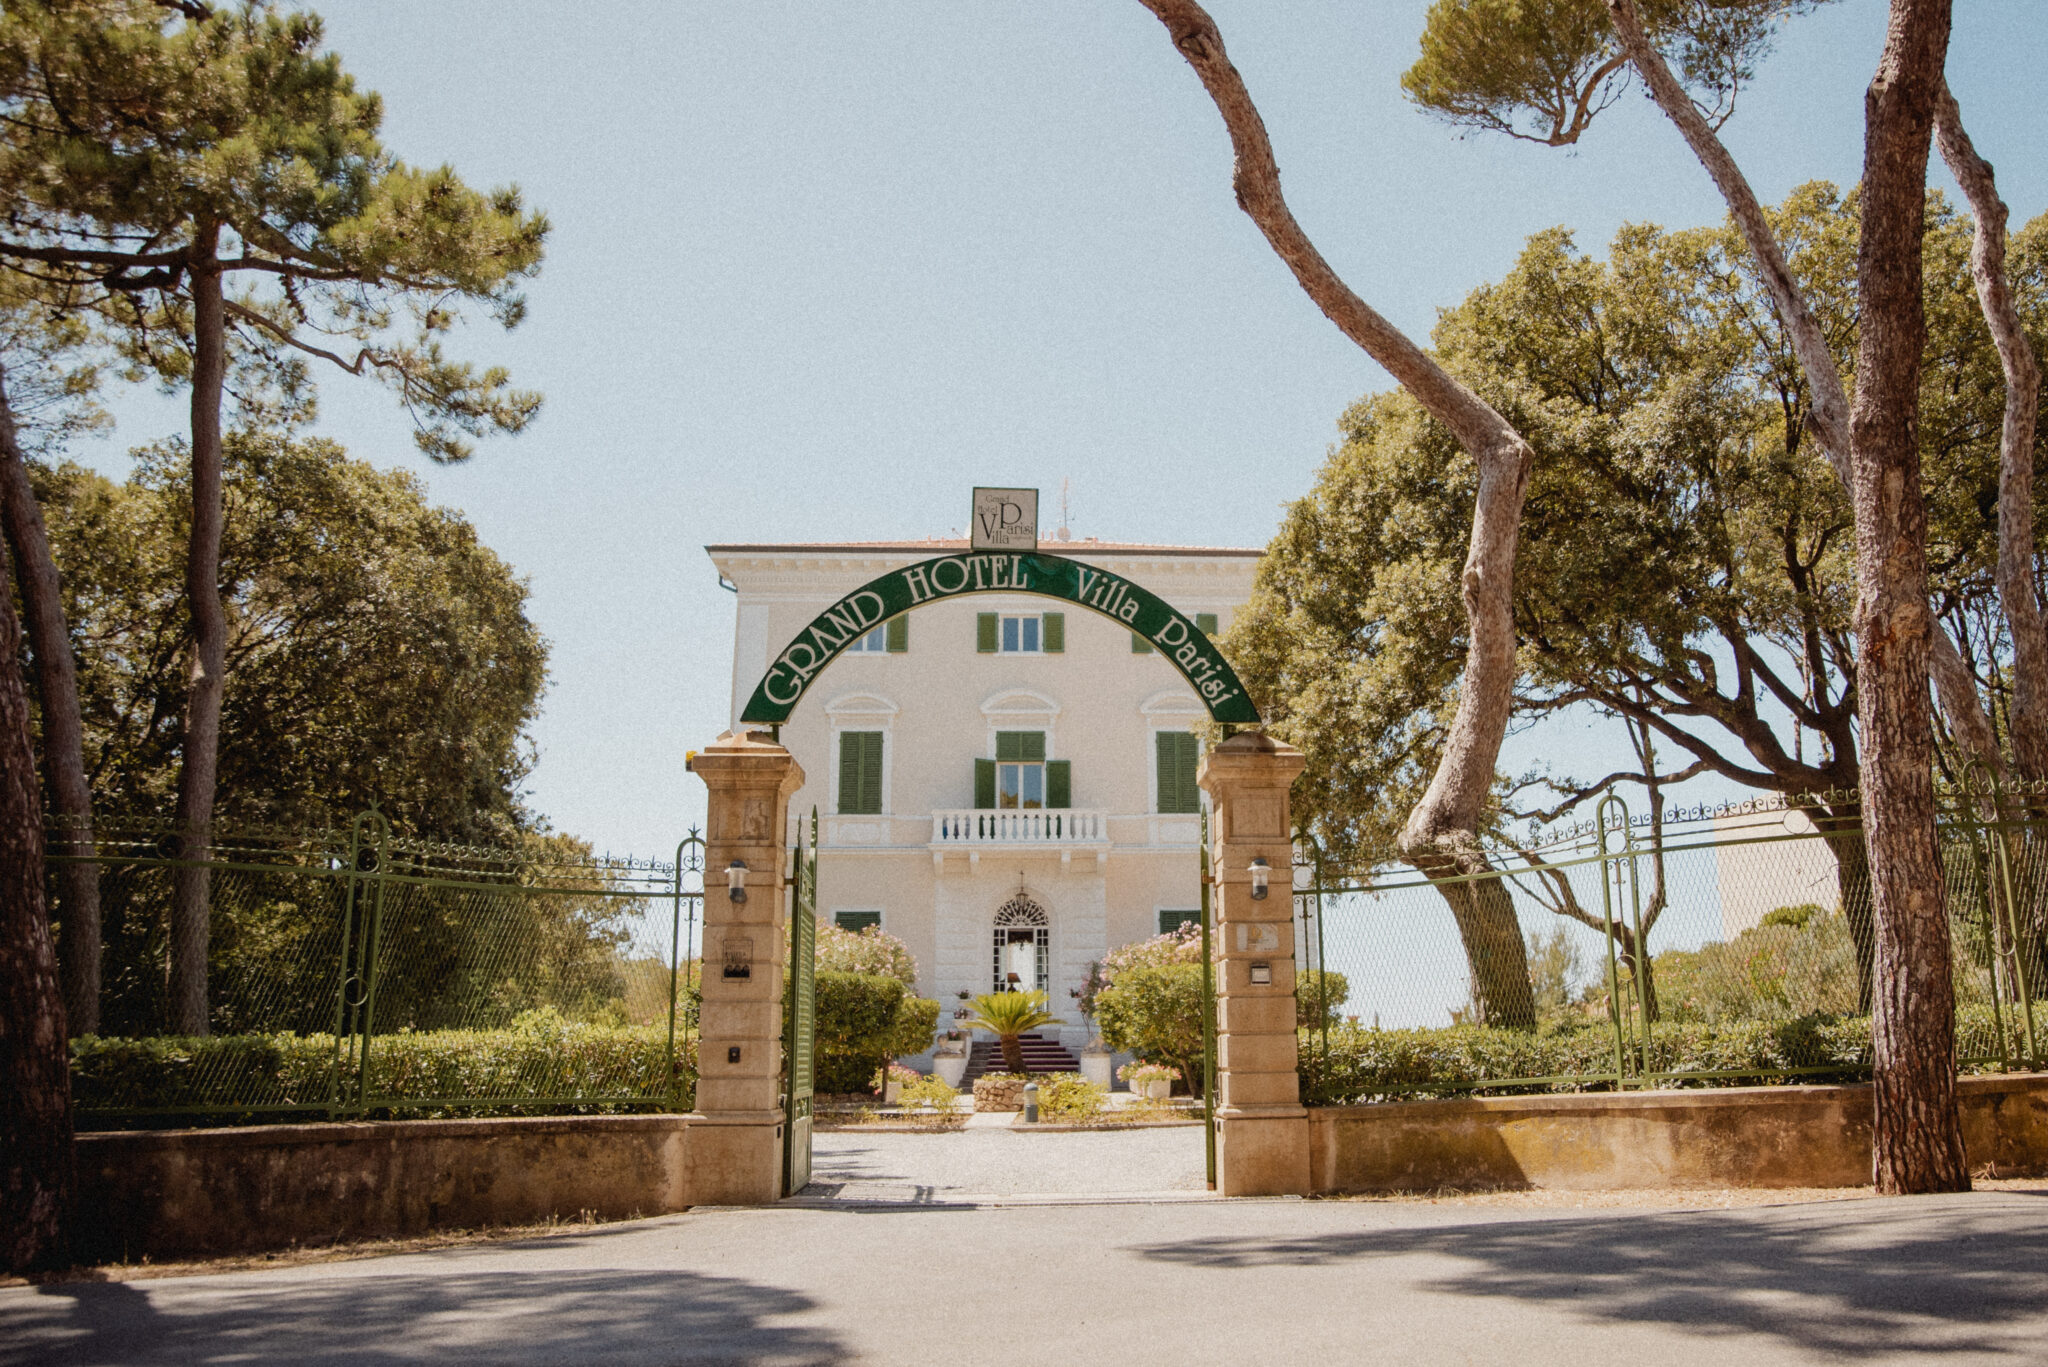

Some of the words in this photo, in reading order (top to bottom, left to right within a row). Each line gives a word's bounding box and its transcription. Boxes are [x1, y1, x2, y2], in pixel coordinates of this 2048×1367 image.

[977, 513, 1010, 544] Villa
[999, 502, 1034, 535] Parisi
[764, 591, 885, 704] GRAND
[902, 555, 1028, 604] HOTEL
[1076, 566, 1139, 623] Villa
[1152, 614, 1239, 708] Parisi
